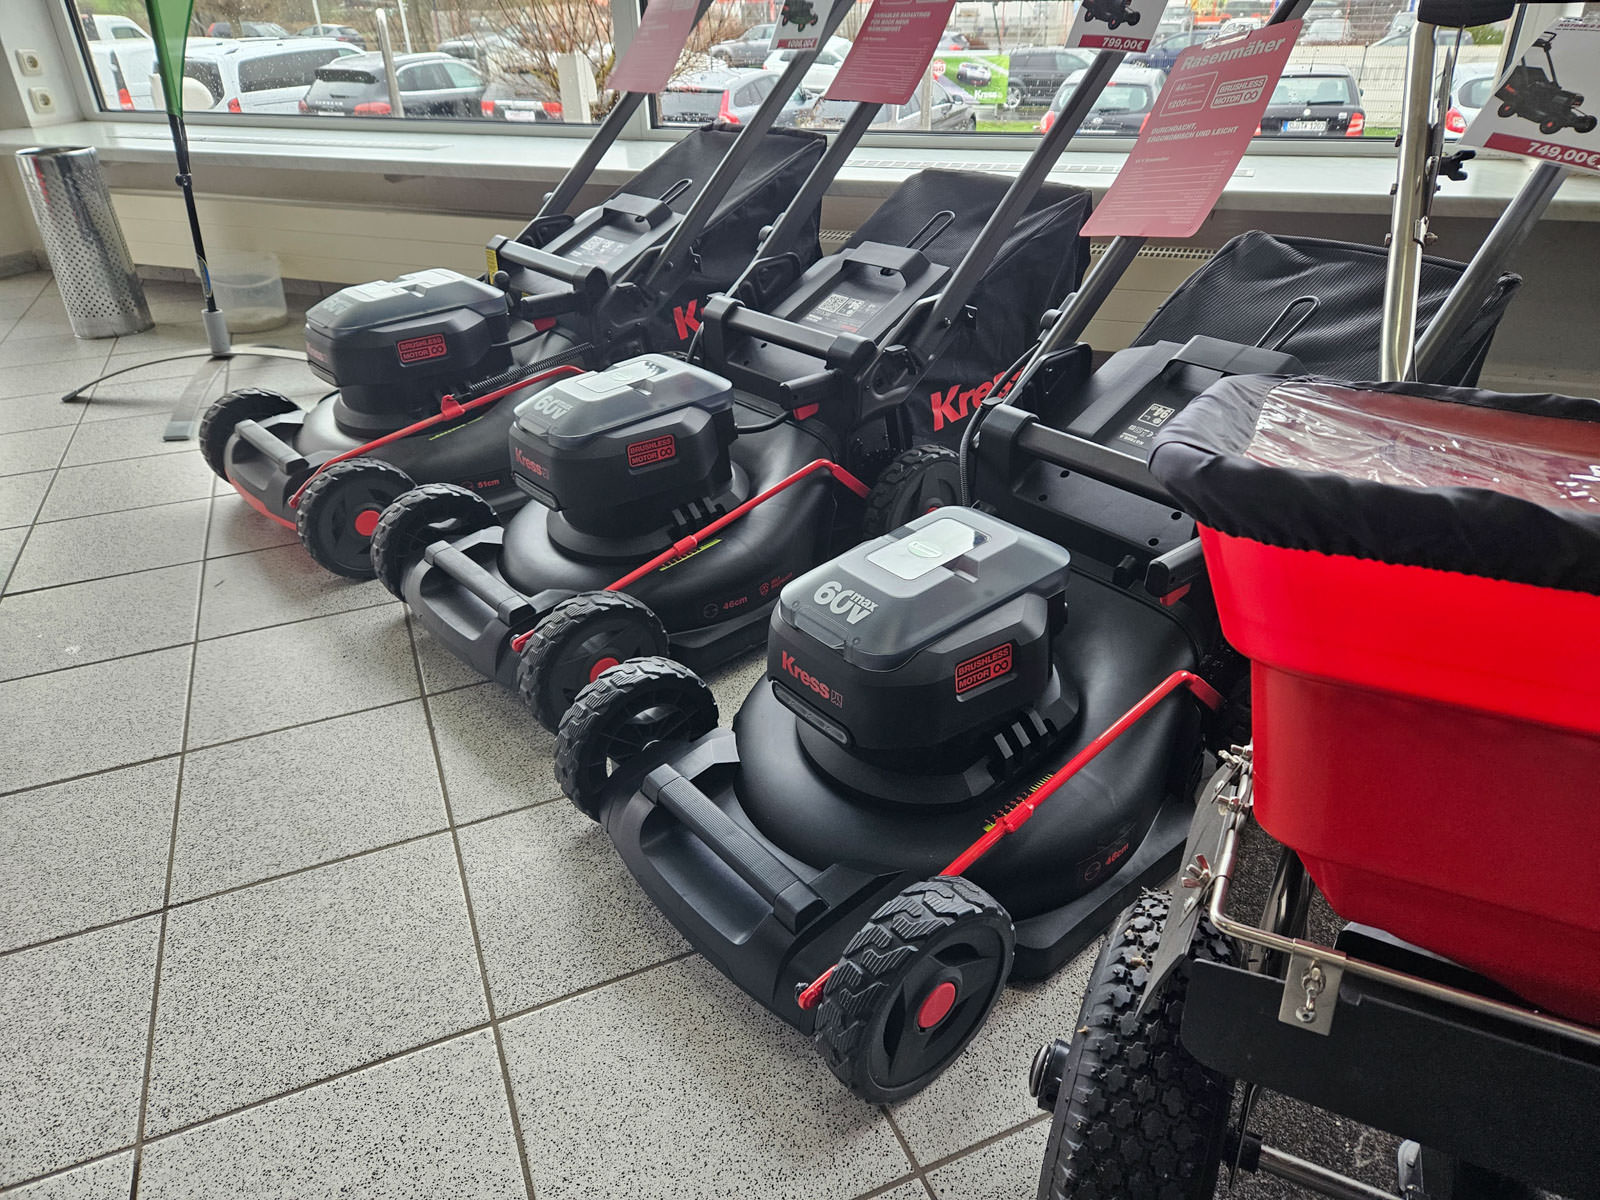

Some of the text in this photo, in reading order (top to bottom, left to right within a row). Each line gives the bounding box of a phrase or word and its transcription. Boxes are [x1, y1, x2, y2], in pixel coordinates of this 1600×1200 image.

[1102, 36, 1145, 50] 799,00€
[1181, 37, 1286, 71] Rasenmäher
[1219, 79, 1264, 93] BRUSHLESS
[1214, 94, 1241, 105] MOTOR
[1528, 141, 1600, 166] 749,00€
[400, 336, 443, 350] BRUSHLESS
[402, 349, 429, 361] MOTOR
[533, 395, 568, 420] 60V
[629, 437, 673, 454] BRUSHLESS
[515, 447, 543, 476] Kress
[631, 453, 658, 465] MOTOR
[722, 596, 748, 610] 46cm
[813, 580, 872, 625] 60V
[851, 591, 880, 614] max
[958, 647, 1010, 677] BRUSHLESS
[781, 650, 830, 700] Kress
[958, 669, 990, 689] MOTOR
